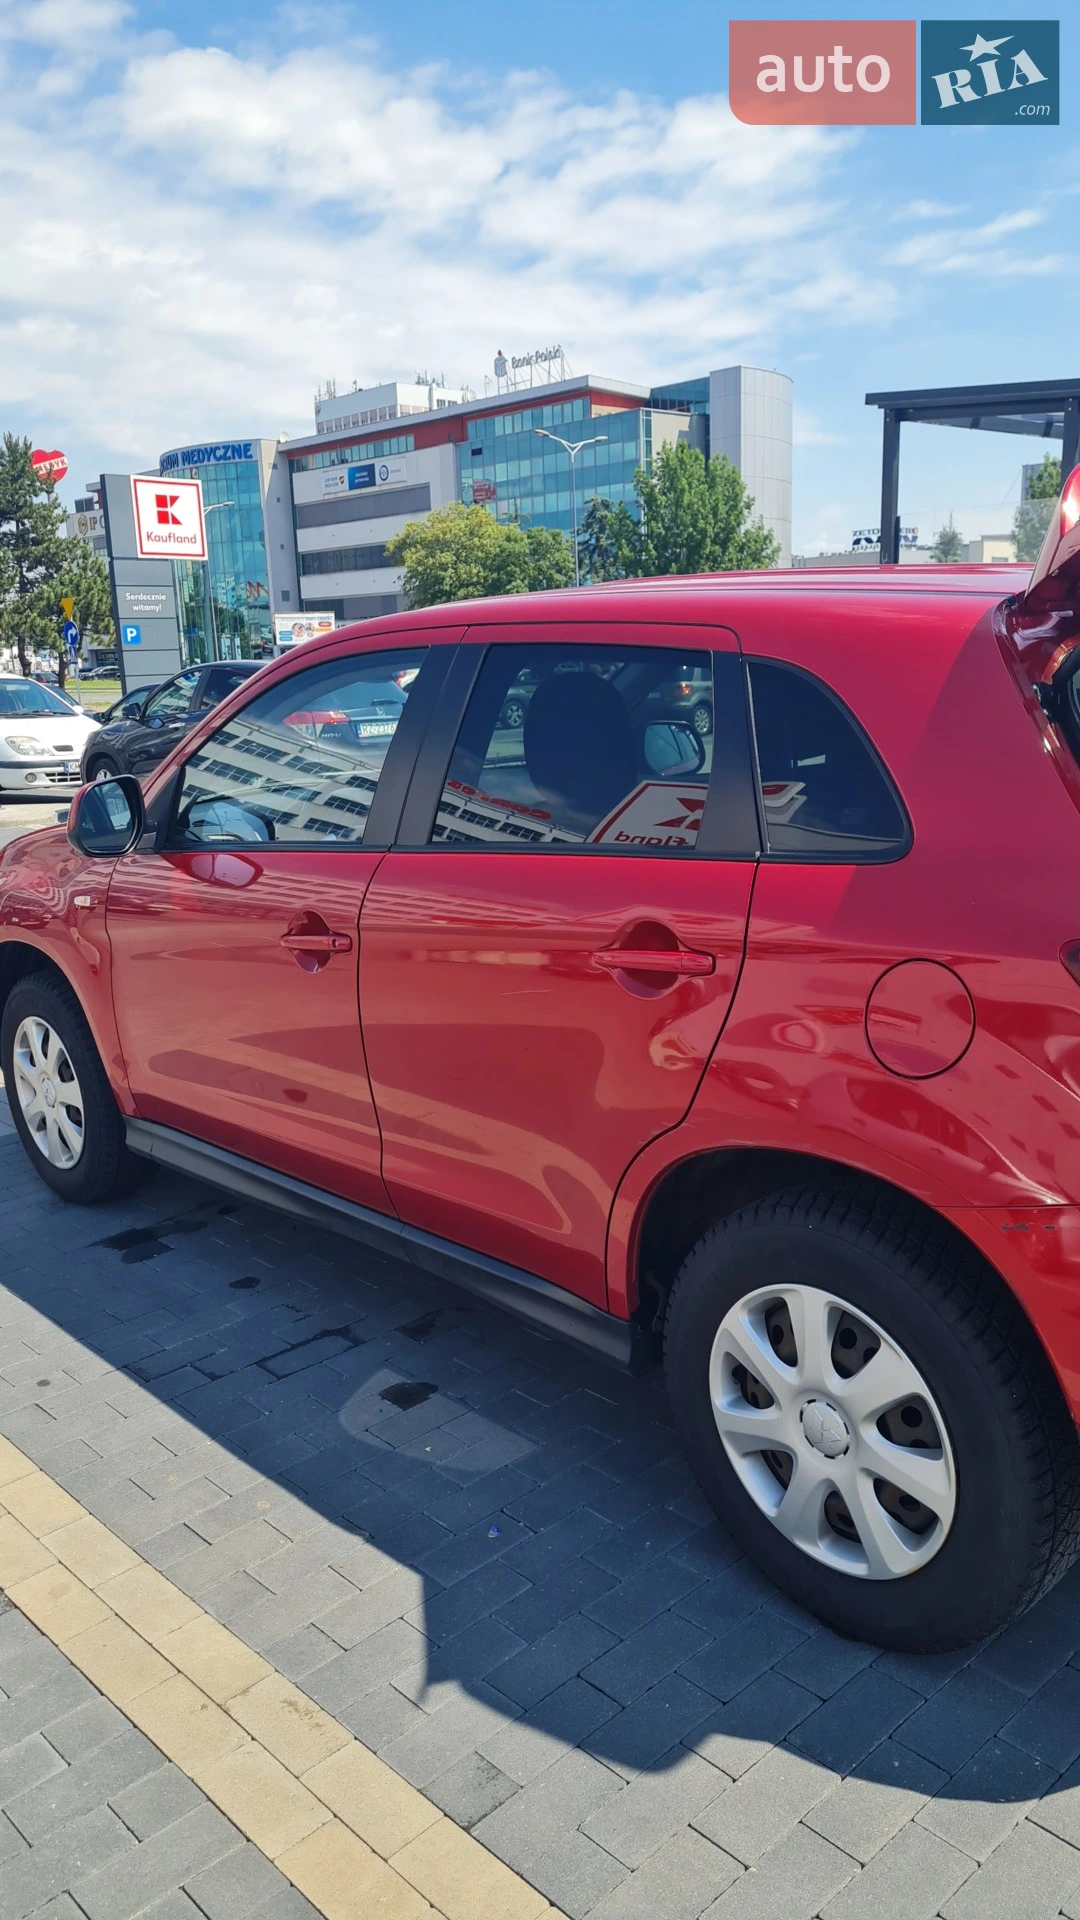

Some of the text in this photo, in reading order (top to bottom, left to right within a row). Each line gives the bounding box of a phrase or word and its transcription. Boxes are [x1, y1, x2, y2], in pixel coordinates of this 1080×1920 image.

[511, 344, 562, 369] Bank Polski
[181, 443, 254, 466] MEDYCZNE
[146, 531, 197, 545] Kaufland
[125, 592, 167, 601] Serdecznie
[132, 603, 162, 613] witamy!
[126, 627, 137, 642] P
